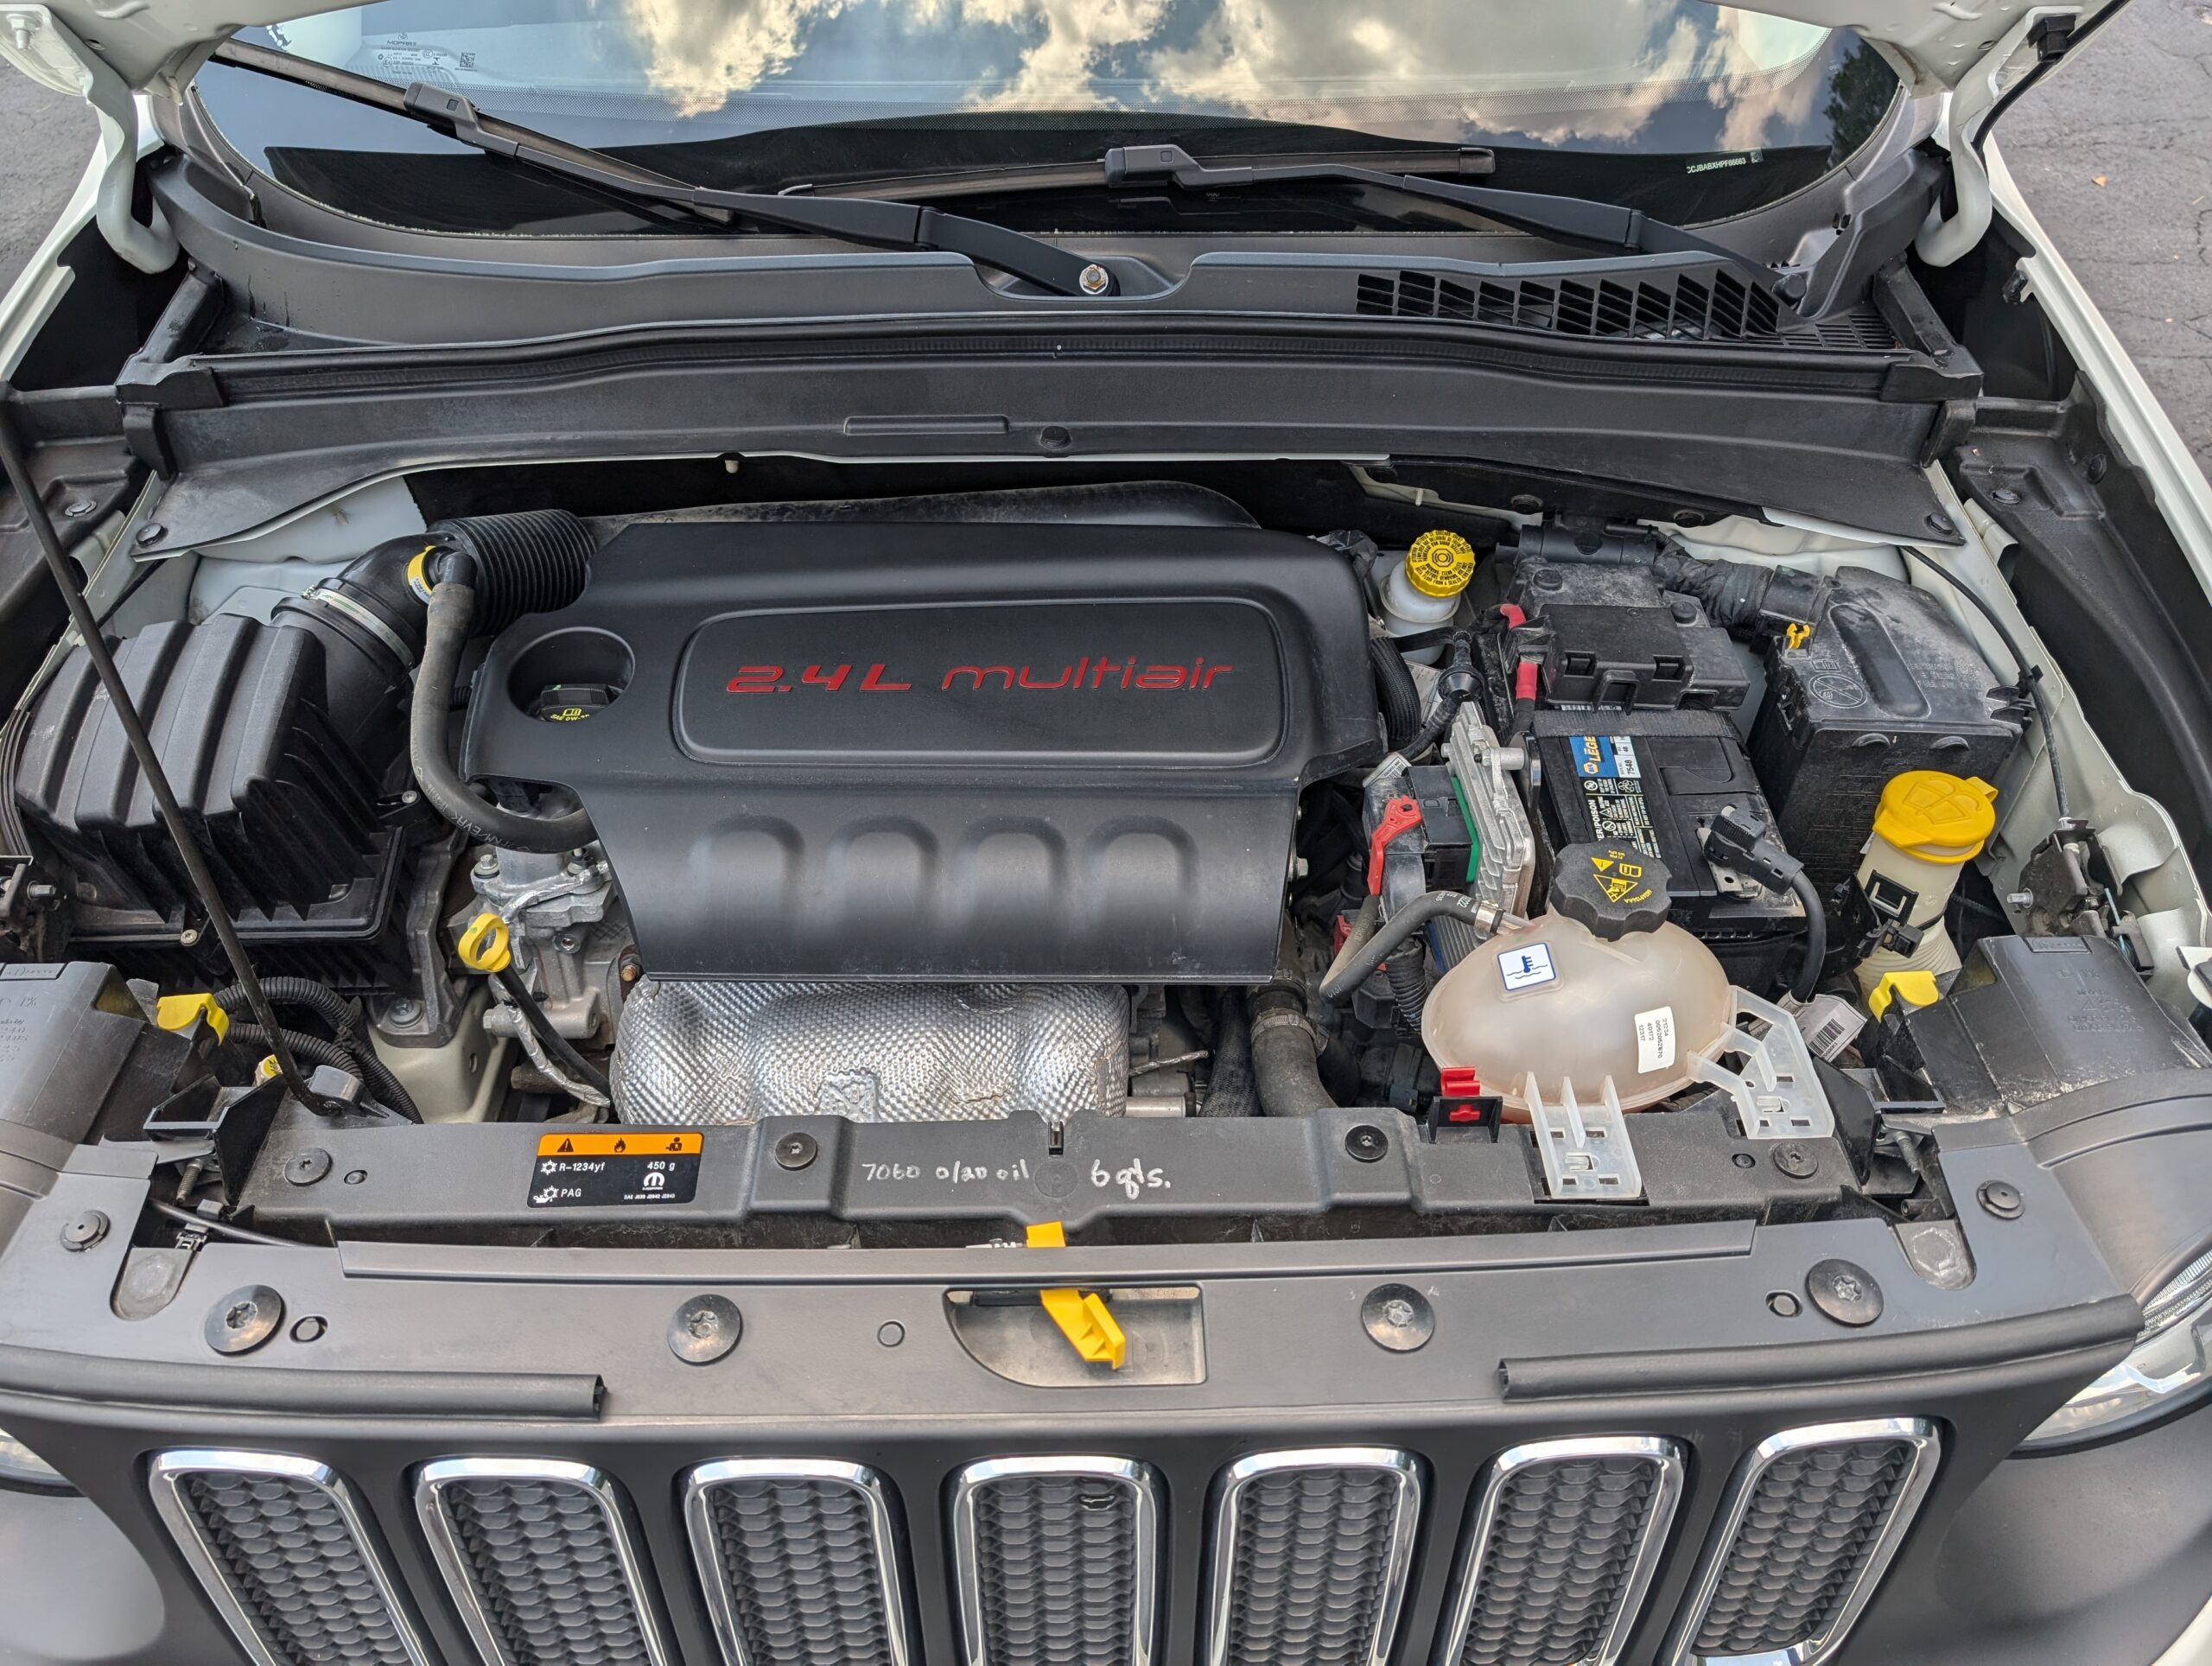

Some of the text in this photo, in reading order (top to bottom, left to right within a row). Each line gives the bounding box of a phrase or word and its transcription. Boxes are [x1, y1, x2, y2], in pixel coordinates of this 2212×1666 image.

[942, 657, 1234, 691] multiair
[1624, 760, 1636, 775] 7548
[1588, 799, 1605, 841] ER/POISON
[558, 1161, 676, 1173] R-1234yf 450 g
[995, 1159, 1029, 1181] oil
[1090, 1159, 1110, 1188] 6
[561, 1188, 582, 1198] PAG
